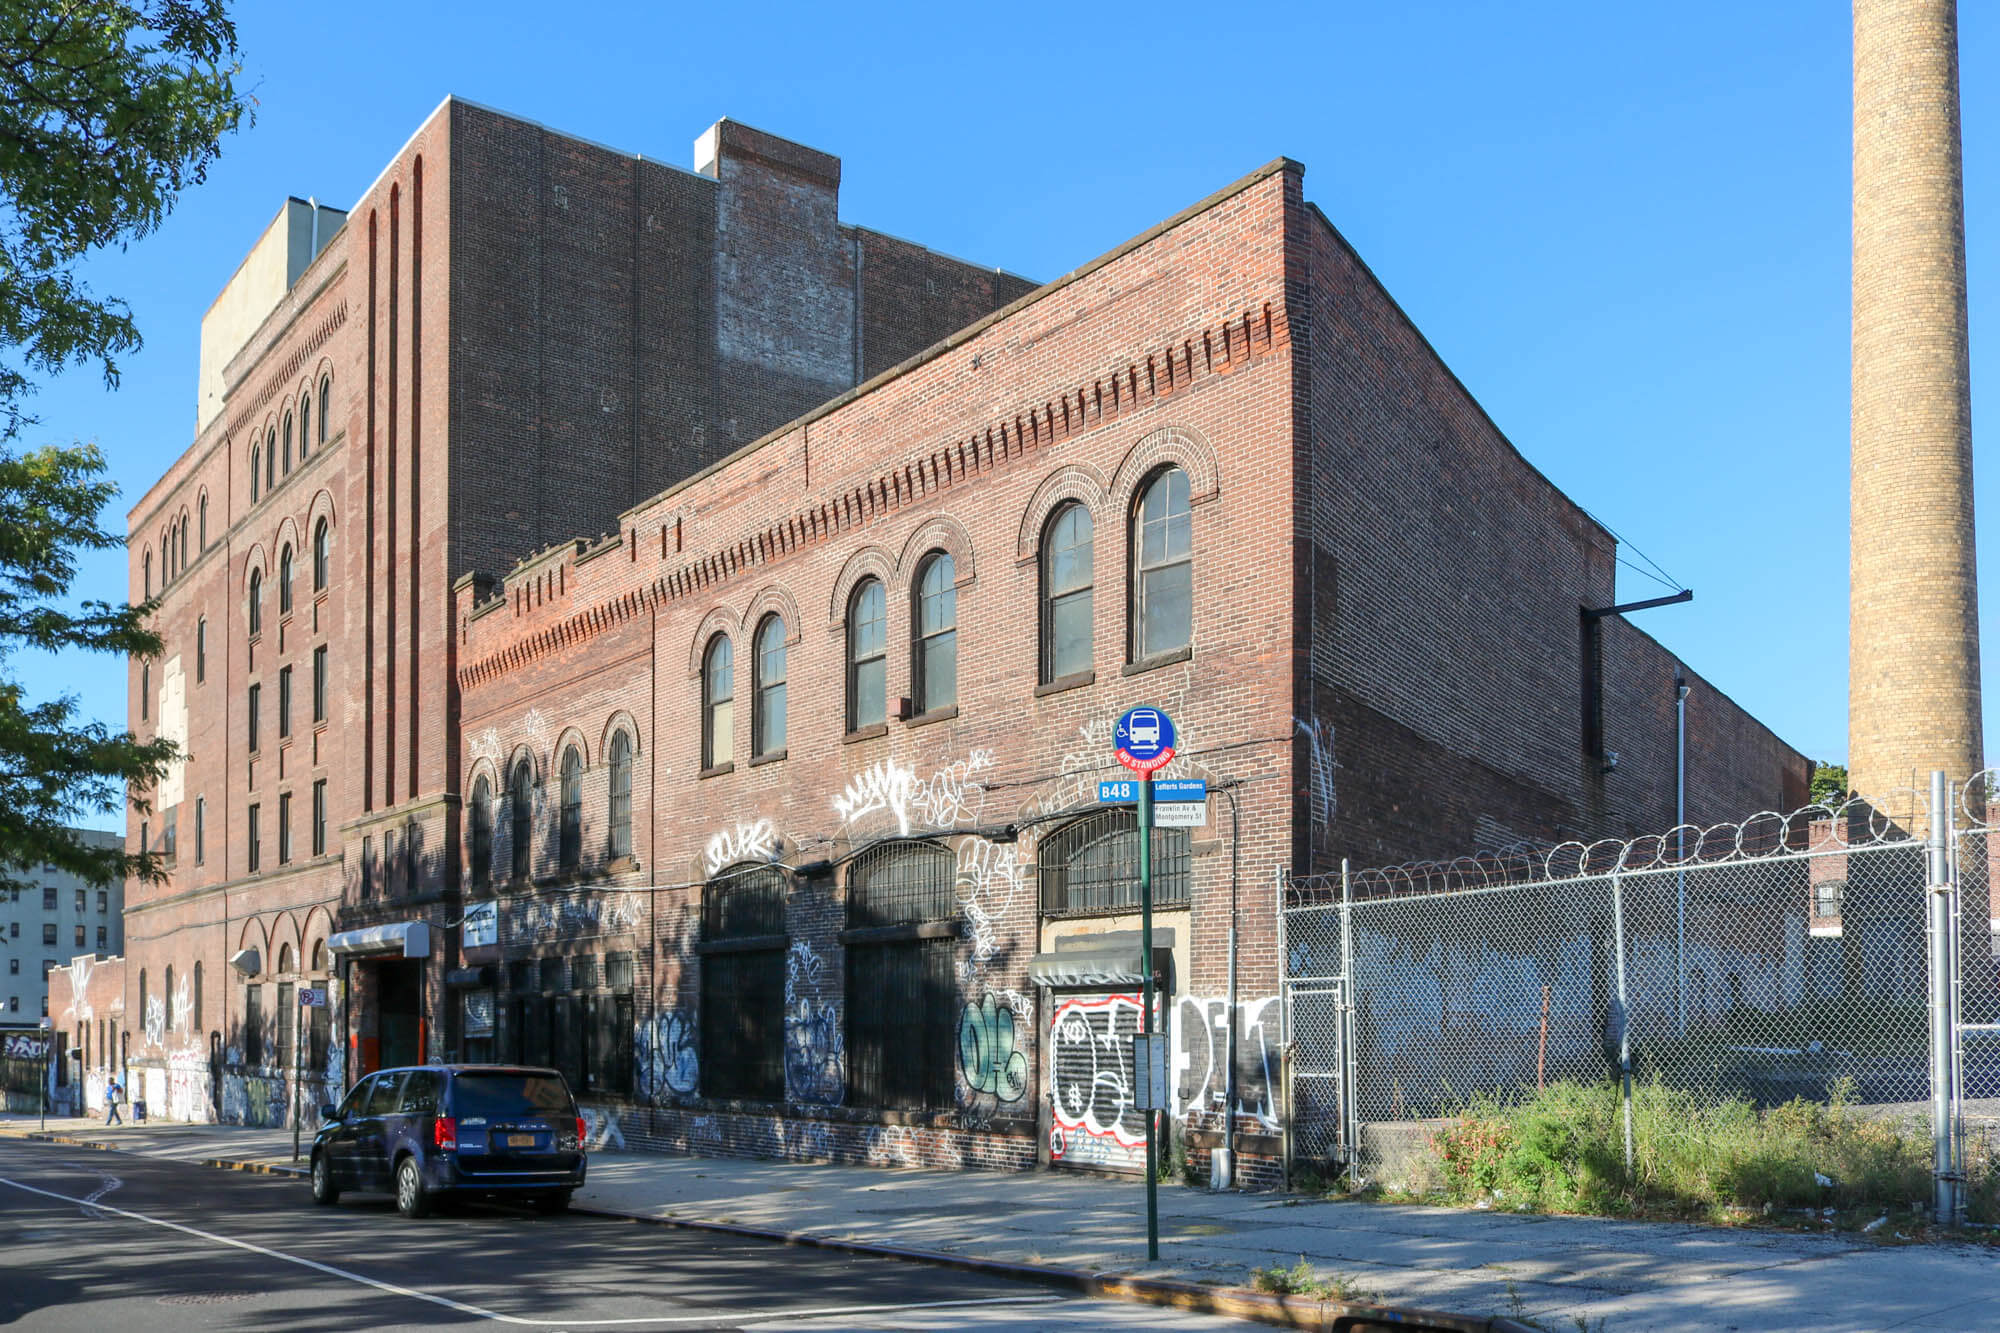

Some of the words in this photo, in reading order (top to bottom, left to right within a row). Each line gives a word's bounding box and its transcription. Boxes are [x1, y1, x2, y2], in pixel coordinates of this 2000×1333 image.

[1120, 752, 1130, 763] NO
[1131, 751, 1170, 769] STANDING
[1102, 783, 1131, 798] B48
[1155, 783, 1178, 791] Lefferts
[1179, 782, 1203, 790] Gardens
